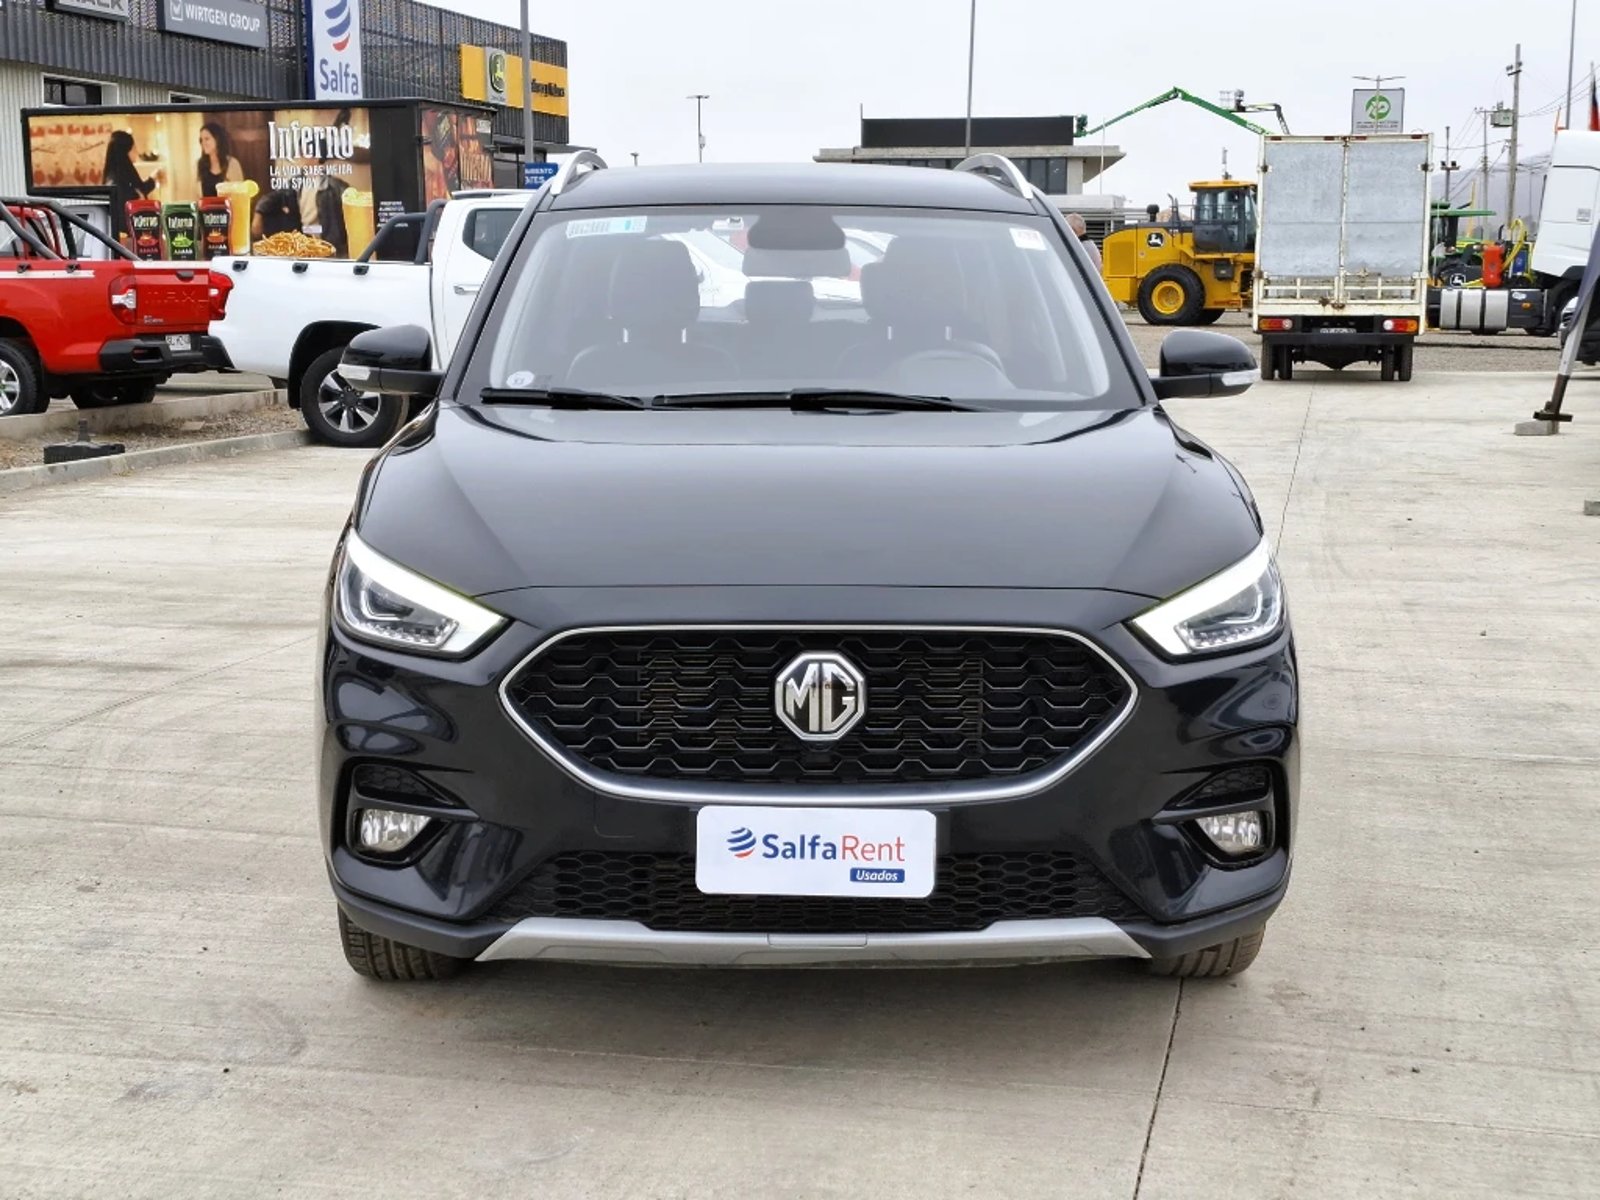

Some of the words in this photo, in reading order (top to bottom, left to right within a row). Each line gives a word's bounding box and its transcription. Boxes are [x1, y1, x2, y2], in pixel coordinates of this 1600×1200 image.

[185, 3, 227, 26] WIRTGEN
[229, 12, 260, 32] GROUP
[319, 57, 359, 96] Salfa
[268, 120, 354, 162] Inferno
[271, 177, 289, 189] CON
[785, 663, 855, 732] MG
[856, 869, 898, 882] Usados
